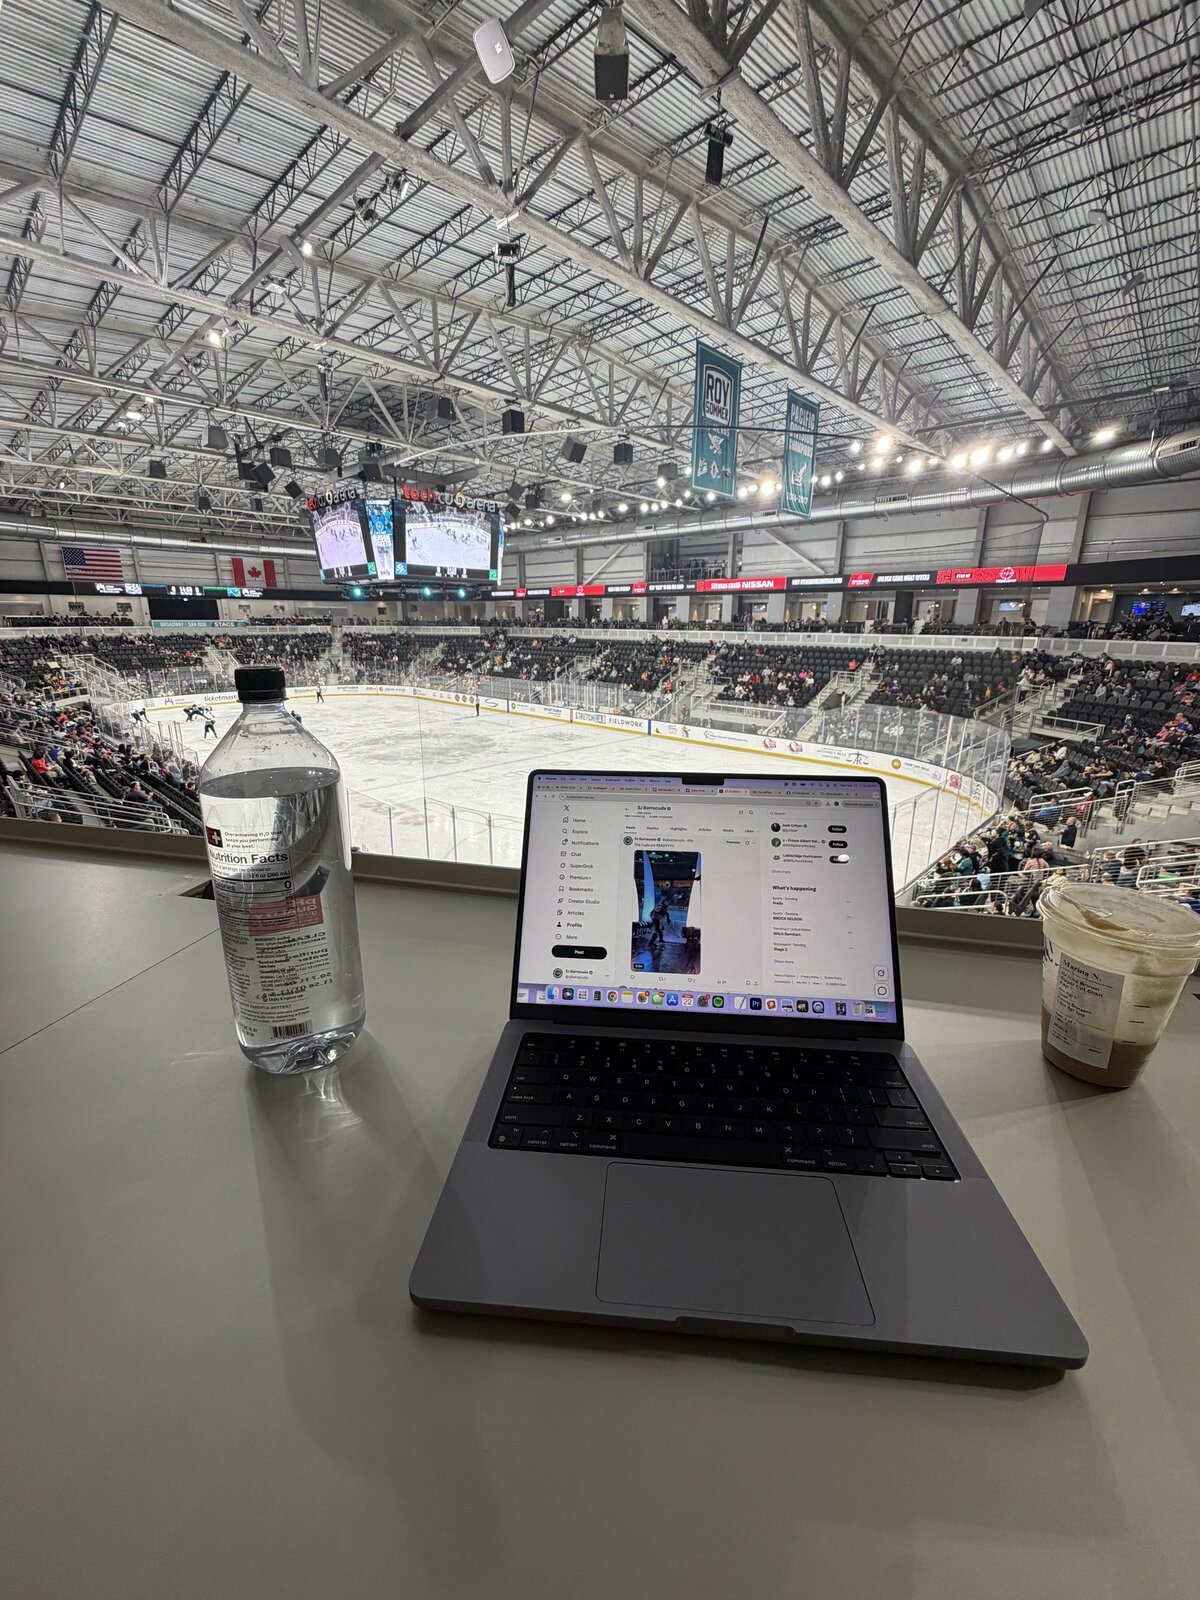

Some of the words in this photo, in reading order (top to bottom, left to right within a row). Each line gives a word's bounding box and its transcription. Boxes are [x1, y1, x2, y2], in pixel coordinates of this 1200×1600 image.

[707, 373, 729, 407] ROY
[706, 401, 728, 421] SOMMER
[791, 403, 815, 430] PACIFIC
[466, 496, 496, 512] arena
[742, 580, 774, 588] NISSAN
[204, 694, 238, 702] ticketmast
[609, 718, 643, 728] FIELDWORK
[209, 848, 247, 864] Nutrition
[251, 852, 289, 864] Facts
[284, 881, 292, 889] 0
[1063, 959, 1089, 977] Marina
[1092, 973, 1102, 982] N.
